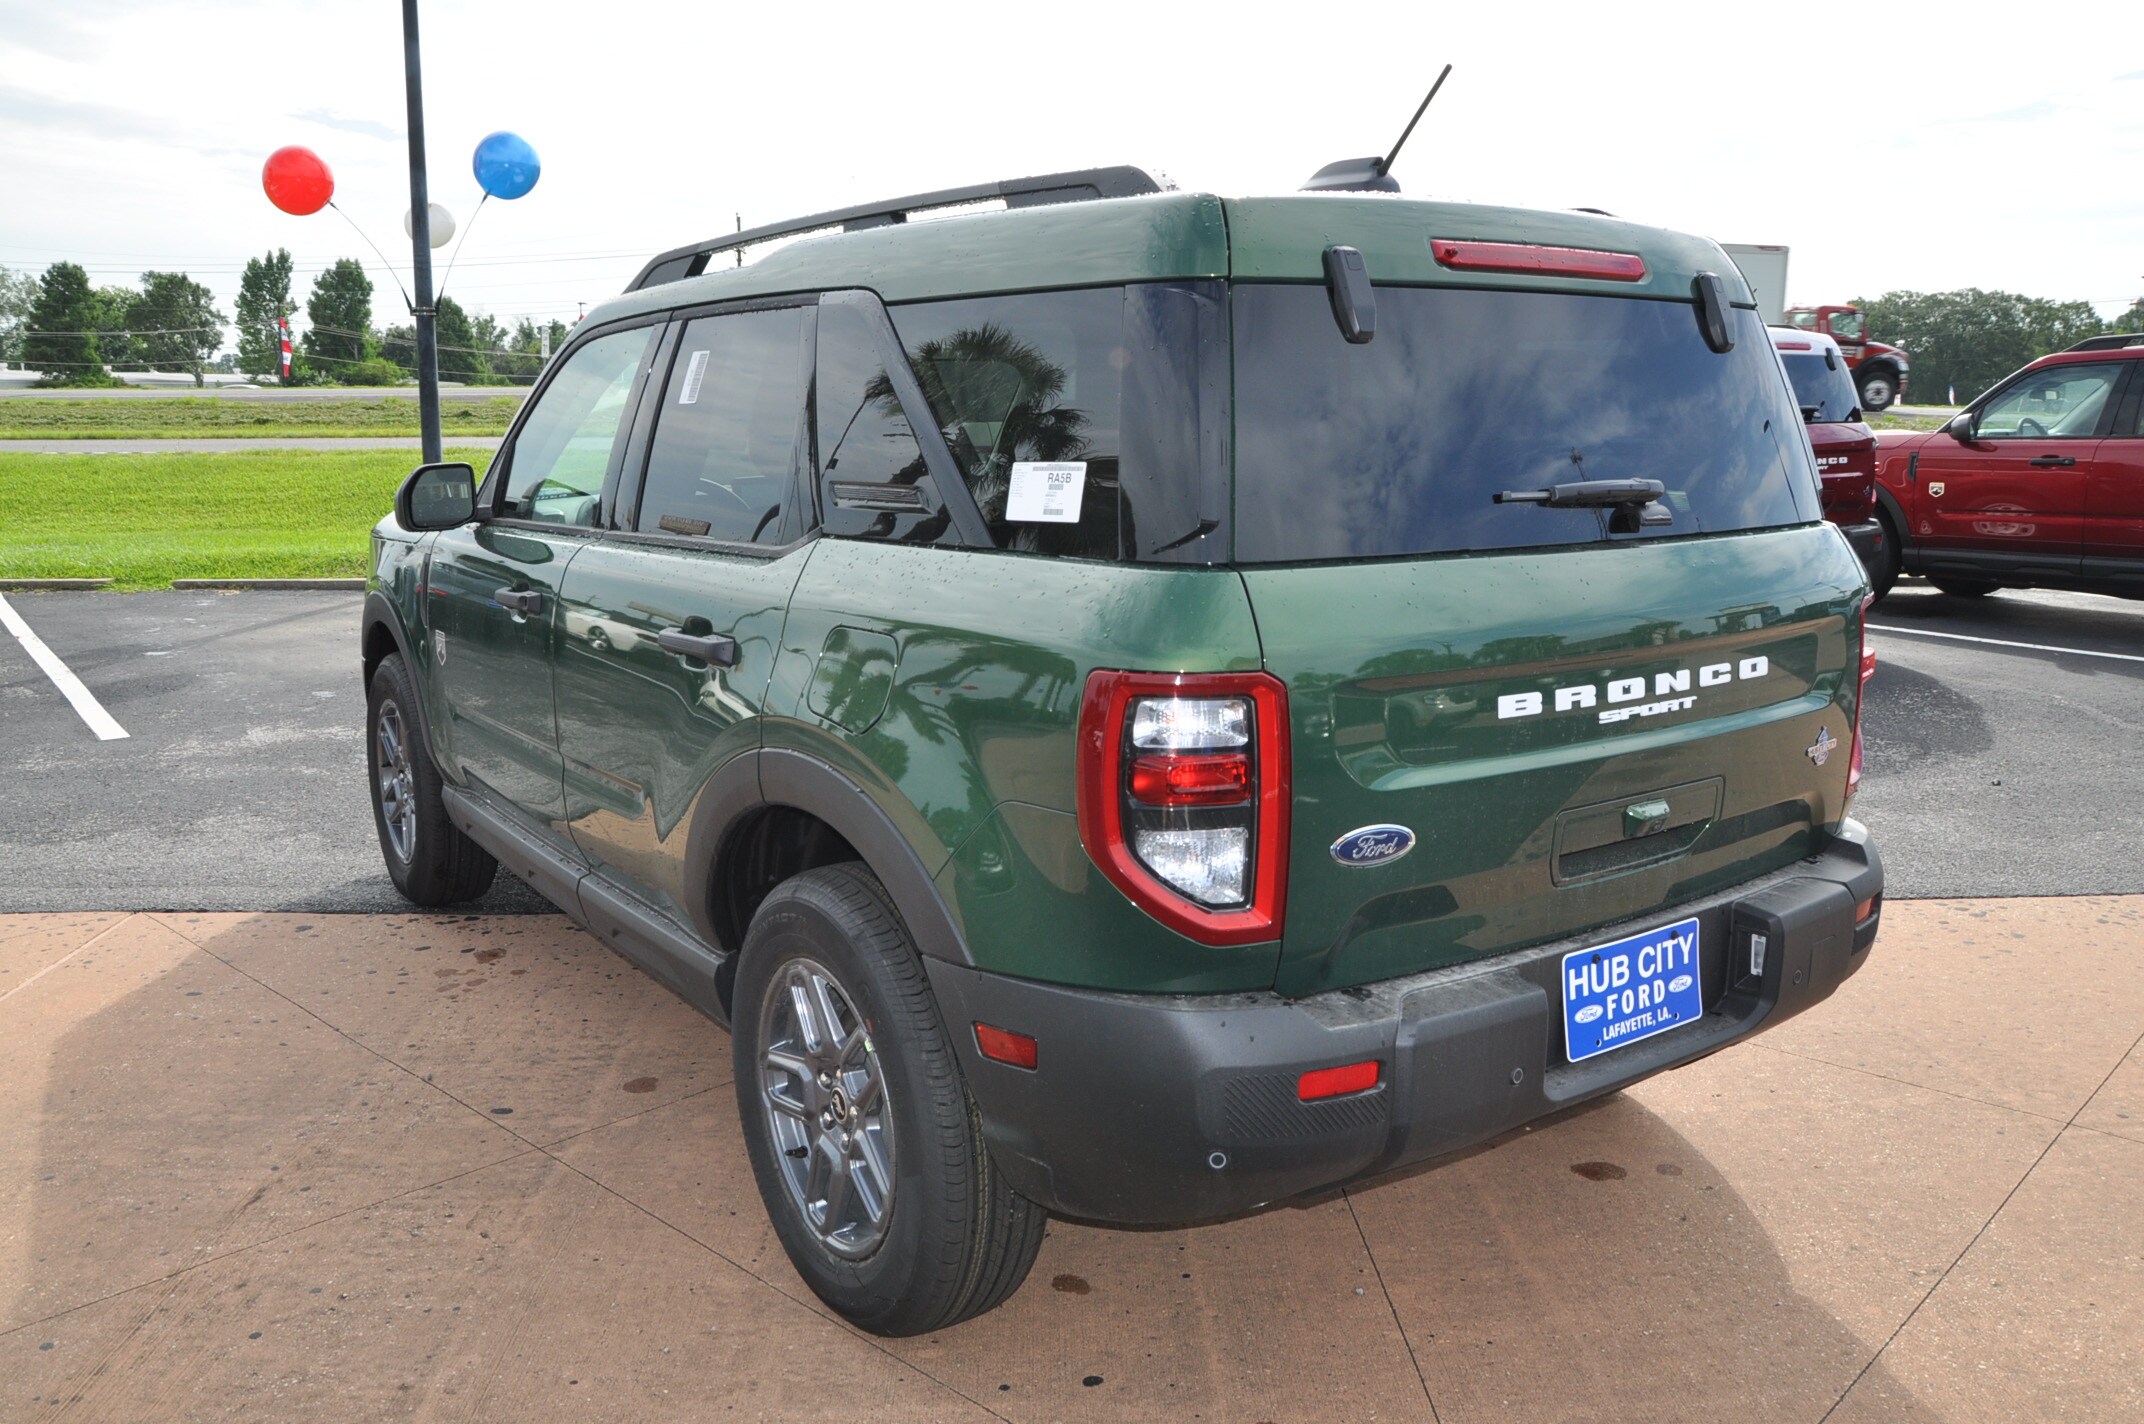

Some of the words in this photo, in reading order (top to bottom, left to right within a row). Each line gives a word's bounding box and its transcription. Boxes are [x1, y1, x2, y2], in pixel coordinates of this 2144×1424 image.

[1816, 456, 1848, 465] NCO
[1047, 472, 1072, 484] RA5B
[1497, 656, 1769, 720] BRONCO
[1598, 696, 1698, 725] SPORT
[1352, 833, 1399, 860] Ford
[1568, 954, 1630, 1001] HUB
[1637, 932, 1695, 979] CITY
[1606, 979, 1666, 1020] FORD
[1602, 1012, 1656, 1041] LAFAYETTE,
[1656, 1006, 1672, 1023] LA.
